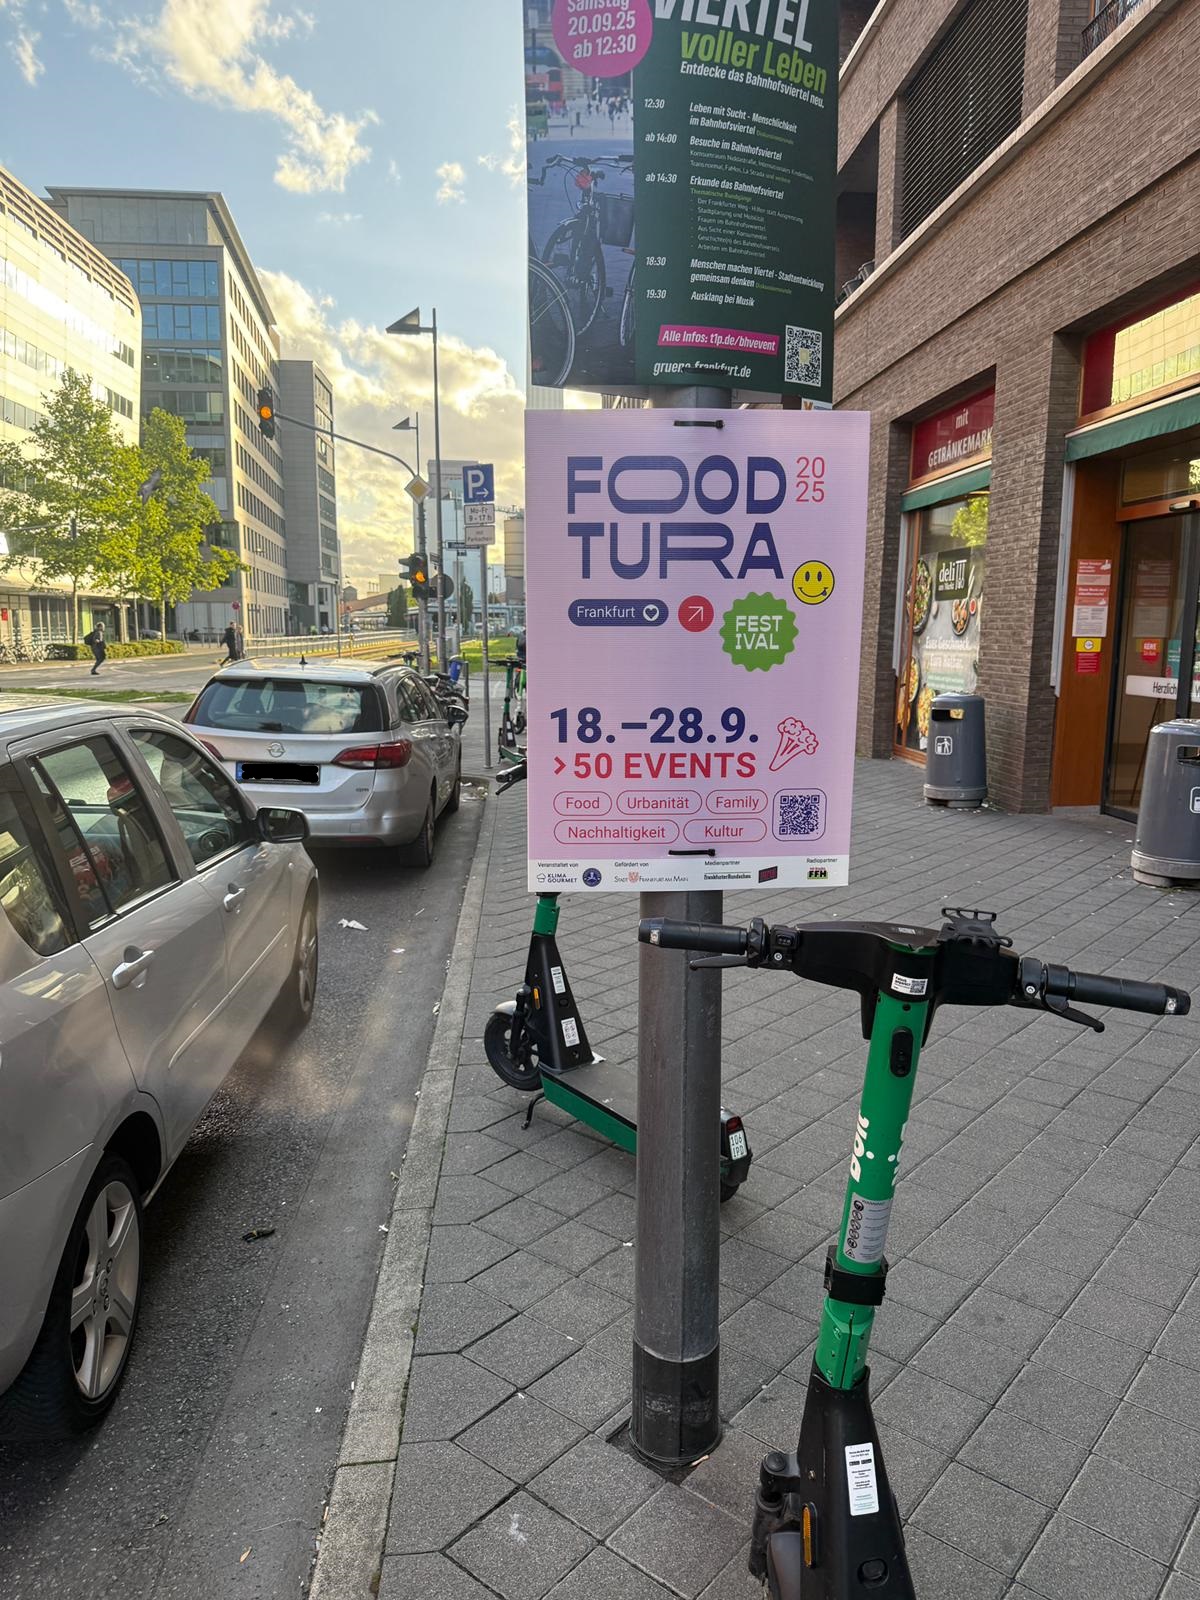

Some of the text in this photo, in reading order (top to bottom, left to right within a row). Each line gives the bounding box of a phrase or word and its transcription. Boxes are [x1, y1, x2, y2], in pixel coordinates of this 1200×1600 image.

[567, 10, 636, 36] 20.09.25
[573, 34, 637, 59] ab 12:30
[681, 30, 827, 95] voller Leben
[680, 61, 825, 108] Entdecke das Bahnhofsviertel neu.
[644, 98, 665, 109] 12:30
[689, 102, 712, 114] Leben
[713, 105, 725, 117] mit
[726, 106, 747, 120] Sucht
[752, 112, 798, 133] Menschlichkeit
[689, 115, 756, 135] im Bahnhofsviertel
[645, 133, 678, 144] ab 14:00
[689, 136, 783, 161] Besuche im Bahnhofsviertel
[645, 172, 678, 184] ab 14:30
[689, 175, 785, 200] Erkunde das Bahnhofsviertel
[646, 256, 667, 266] 18:30
[690, 258, 726, 271] Menschen
[727, 263, 753, 275] machen
[753, 266, 774, 278] Viertel
[778, 270, 825, 292] Stadtentwicklung
[690, 273, 730, 284] gemeinsam
[730, 276, 755, 288] denken
[646, 289, 667, 299] 19:30
[690, 291, 755, 307] Ausklang bei Musik
[662, 330, 776, 351] Alle Infos: t1p.de/bhvevent
[653, 360, 752, 378] gruenfkfrt.de
[955, 408, 969, 429] mit
[795, 456, 826, 479] 20
[467, 469, 485, 499] P
[567, 454, 787, 515] FOOD
[795, 480, 825, 503] 25
[567, 522, 785, 580] TURA
[939, 562, 955, 582] deli
[576, 606, 635, 618] Frankfurt
[735, 615, 783, 632] FEST
[735, 633, 779, 650] IVAL
[574, 753, 613, 779] 50
[624, 751, 756, 779] EVENTS
[566, 796, 600, 810] Food
[627, 796, 689, 810] Urbanität
[716, 795, 760, 811] Family
[568, 825, 666, 841] Nachhaltigkeit
[704, 824, 744, 838] Kultur
[808, 870, 827, 878] FFH
